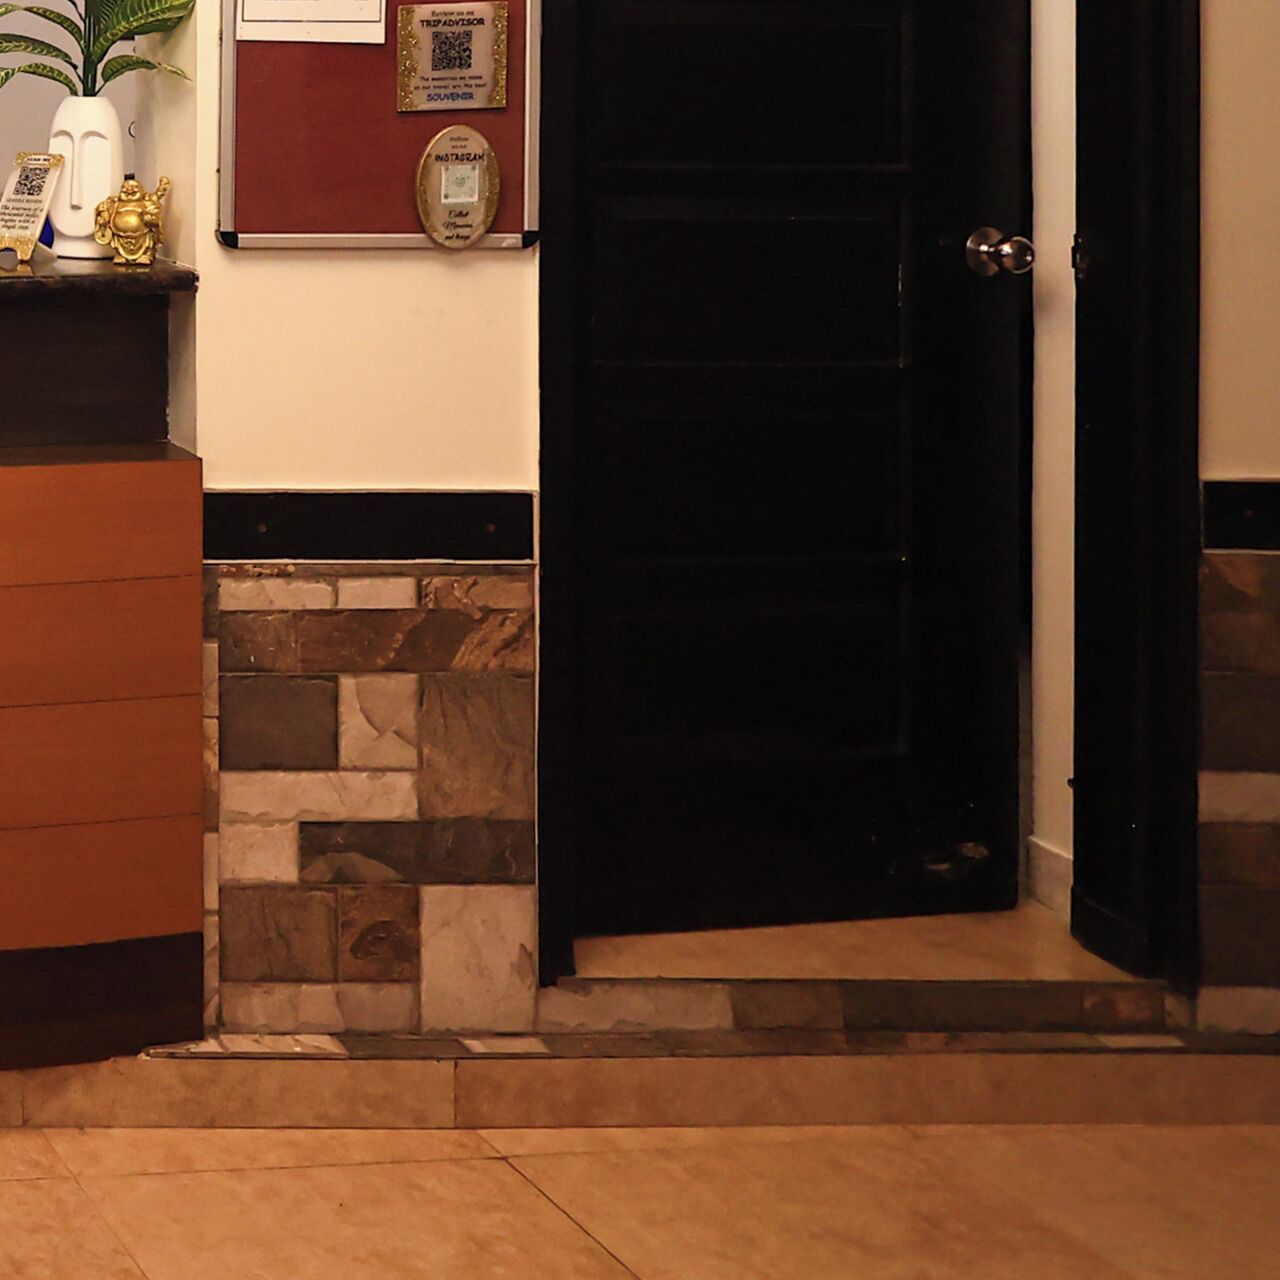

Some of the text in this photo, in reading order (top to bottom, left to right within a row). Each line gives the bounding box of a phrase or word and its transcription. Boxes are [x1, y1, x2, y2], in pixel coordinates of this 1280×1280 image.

[420, 18, 486, 27] TRIPADVISOR
[426, 92, 474, 102] SOUVENIR
[435, 153, 485, 162] INSTAGRAM
